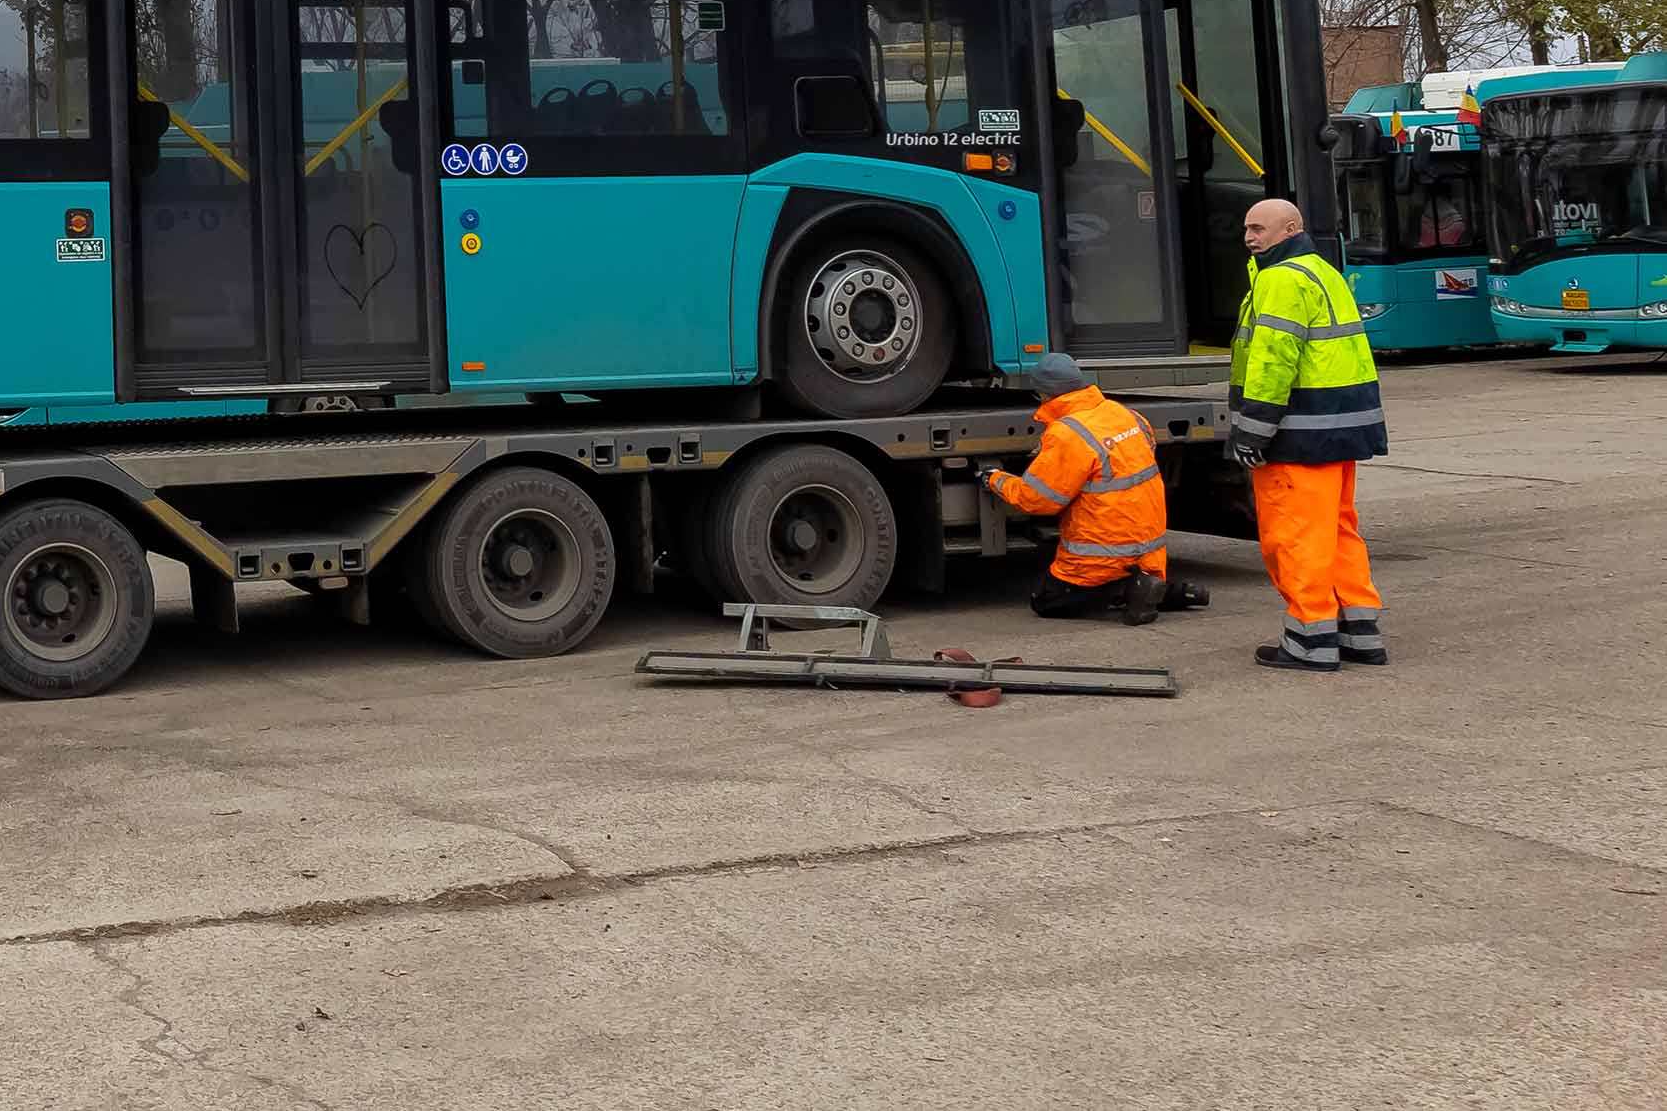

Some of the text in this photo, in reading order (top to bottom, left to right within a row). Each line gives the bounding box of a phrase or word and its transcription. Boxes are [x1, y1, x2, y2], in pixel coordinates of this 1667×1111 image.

[886, 132, 1021, 146] Urbino 12 electric
